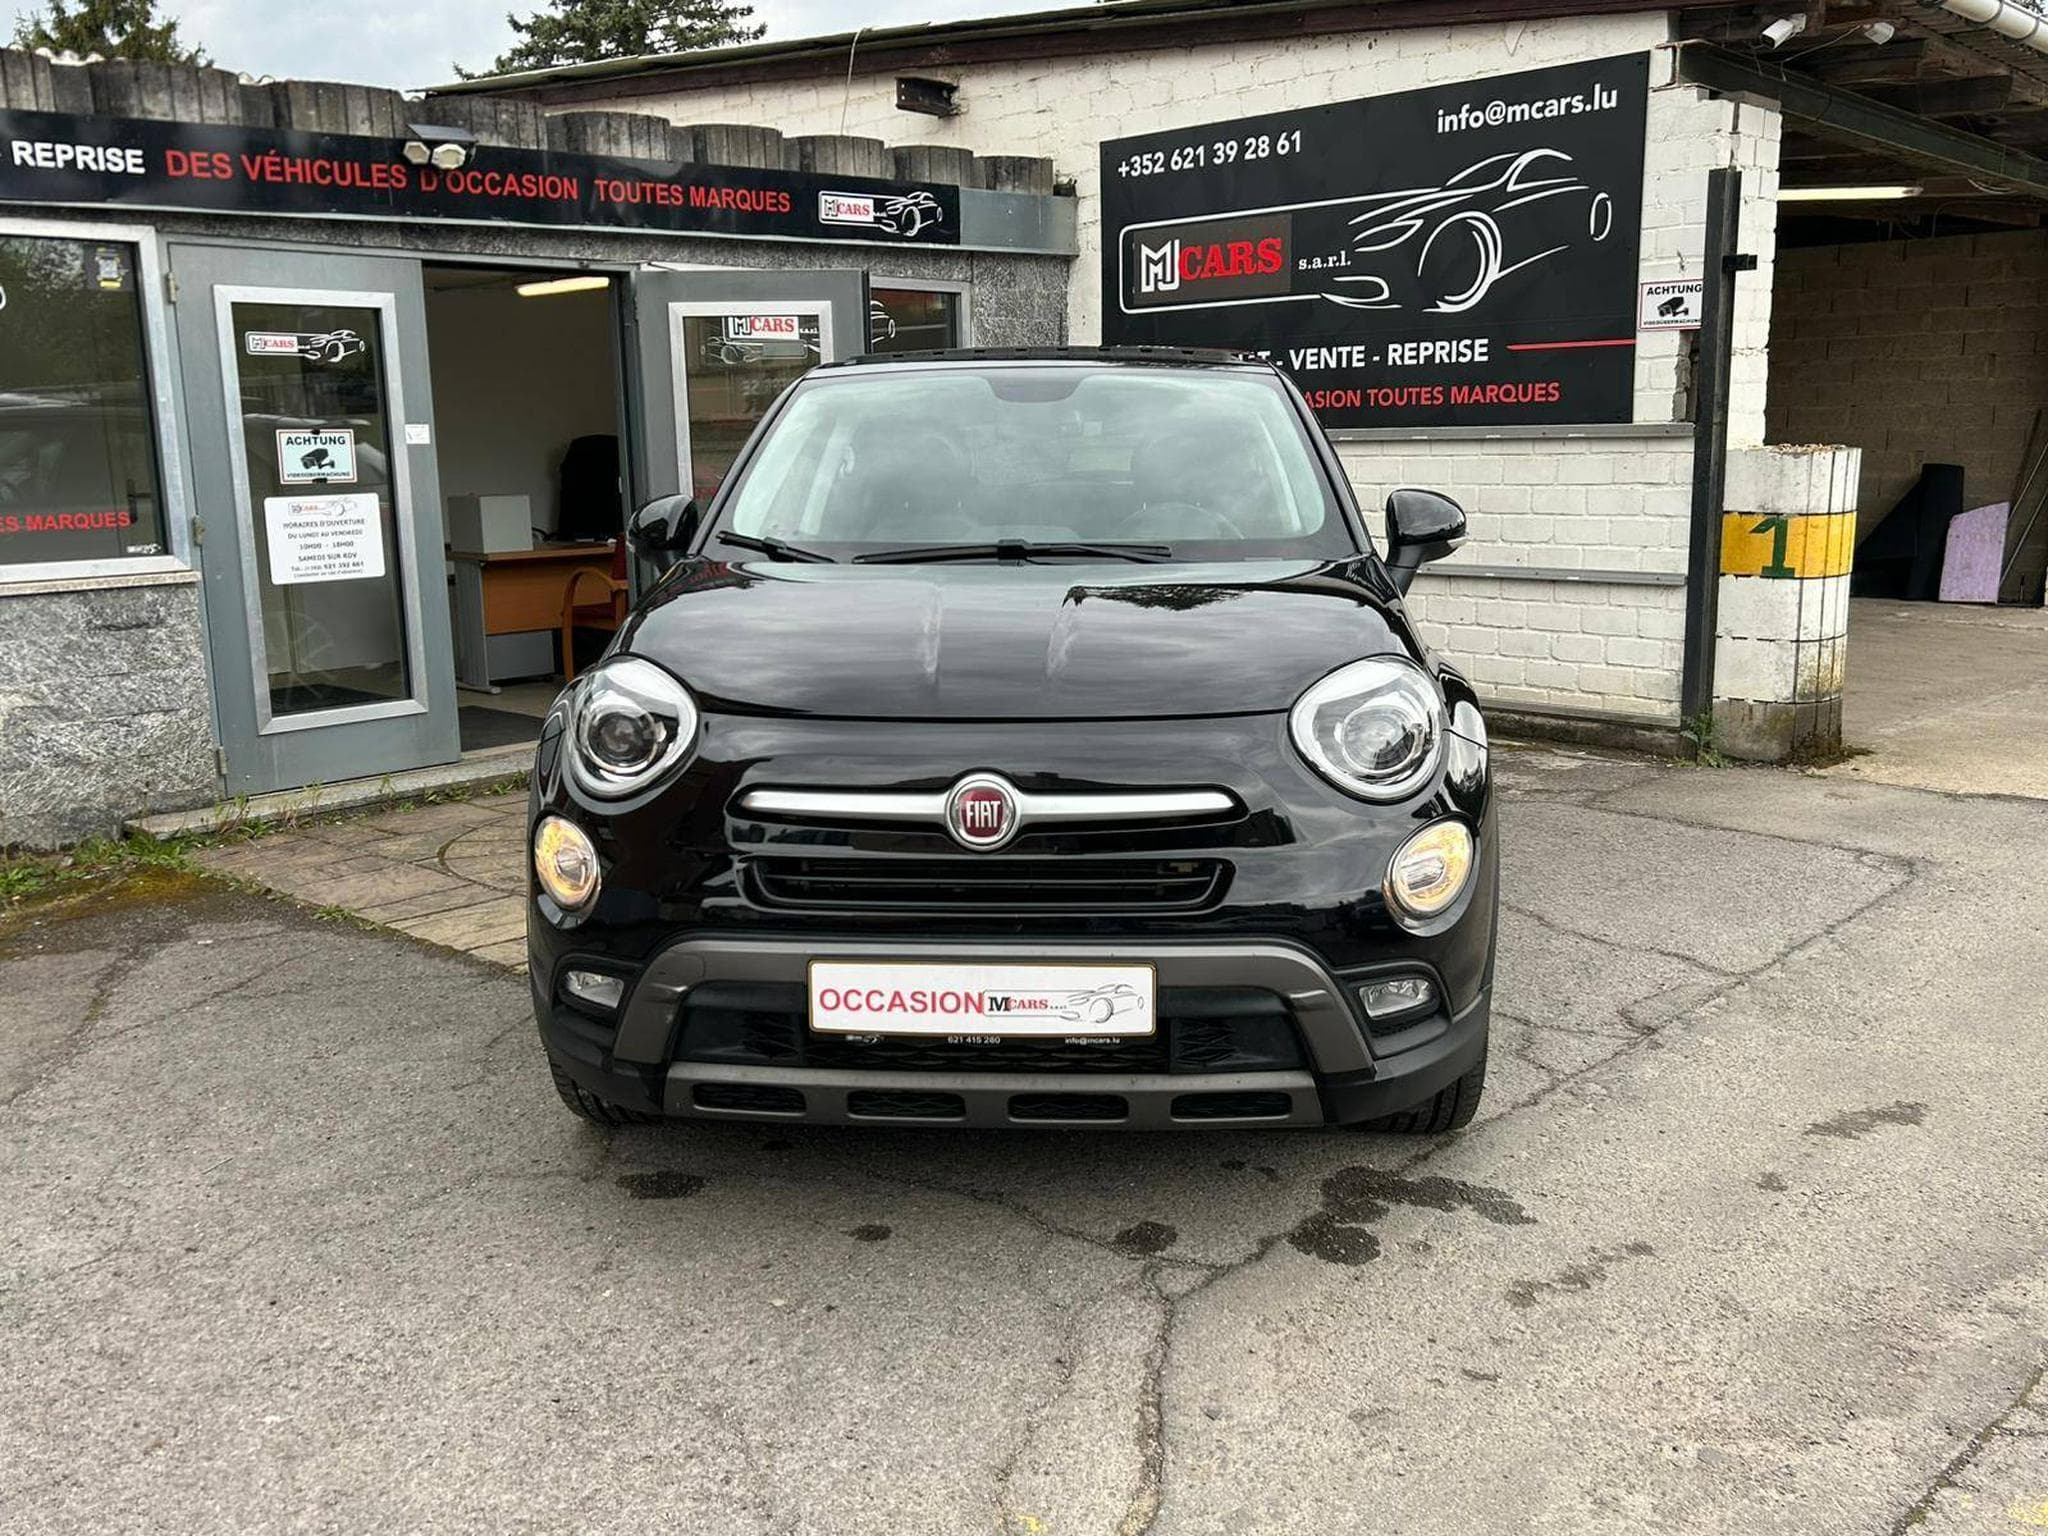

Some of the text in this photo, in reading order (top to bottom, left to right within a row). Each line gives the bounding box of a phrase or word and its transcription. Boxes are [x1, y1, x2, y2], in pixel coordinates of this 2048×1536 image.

[1437, 83, 1618, 133] info@mcars.lu
[1118, 130, 1301, 177] +352 621 39 28 61
[11, 140, 146, 174] REPRISE
[165, 150, 233, 180] DES
[240, 149, 408, 188] VÉHICULES
[594, 179, 684, 206] TOUTES
[689, 185, 791, 213] MARQUES
[1298, 250, 1352, 270] s.a.r.l.
[1646, 283, 1703, 296] ACHTUNG
[1289, 345, 1366, 371] VENTE
[1387, 338, 1490, 366] REPRISE
[1367, 386, 1444, 407] TOUTES
[1450, 382, 1561, 404] MARQUES
[285, 435, 346, 446] ACHTUNG
[25, 512, 131, 530] MARQUES
[1749, 516, 1796, 578] 1
[966, 800, 1001, 828] FIAT
[819, 988, 984, 1014] OCCASION
